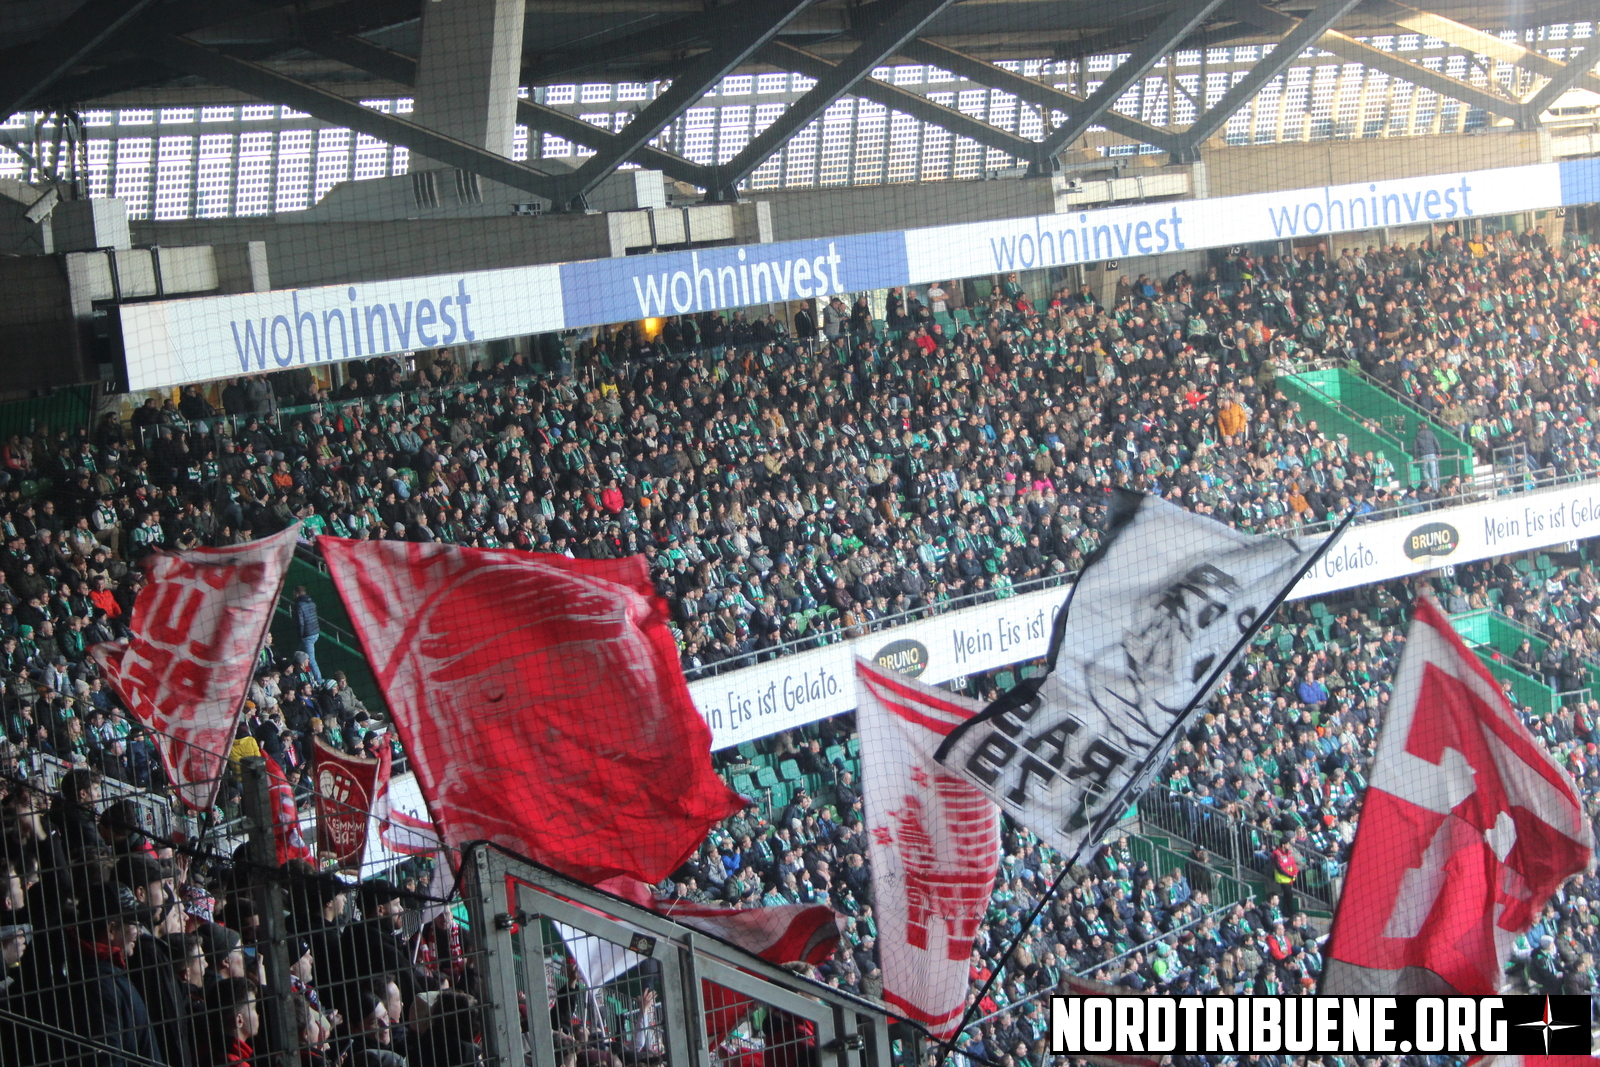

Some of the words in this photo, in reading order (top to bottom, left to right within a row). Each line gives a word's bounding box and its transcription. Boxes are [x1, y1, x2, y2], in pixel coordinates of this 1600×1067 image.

[1268, 176, 1473, 236] wohninvest
[990, 206, 1185, 271] wohninvest
[632, 241, 844, 317] wohninvest
[230, 279, 475, 371] wohninvest
[1411, 529, 1451, 549] BRUNO
[1484, 515, 1520, 545] Mein
[1524, 507, 1544, 538] Eis
[1549, 502, 1565, 528] ist
[1571, 496, 1600, 528] Gela
[1324, 541, 1378, 578] Gelato.
[1566, 540, 1578, 552] 14
[1441, 565, 1455, 577] 16
[878, 647, 919, 670] BRUNO
[952, 628, 993, 664] Mein
[998, 617, 1021, 653] Eis
[1026, 608, 1045, 641] ist
[728, 691, 752, 730] Eis
[757, 680, 777, 716] ist
[783, 666, 842, 712] Gelato.
[952, 675, 967, 689] 18
